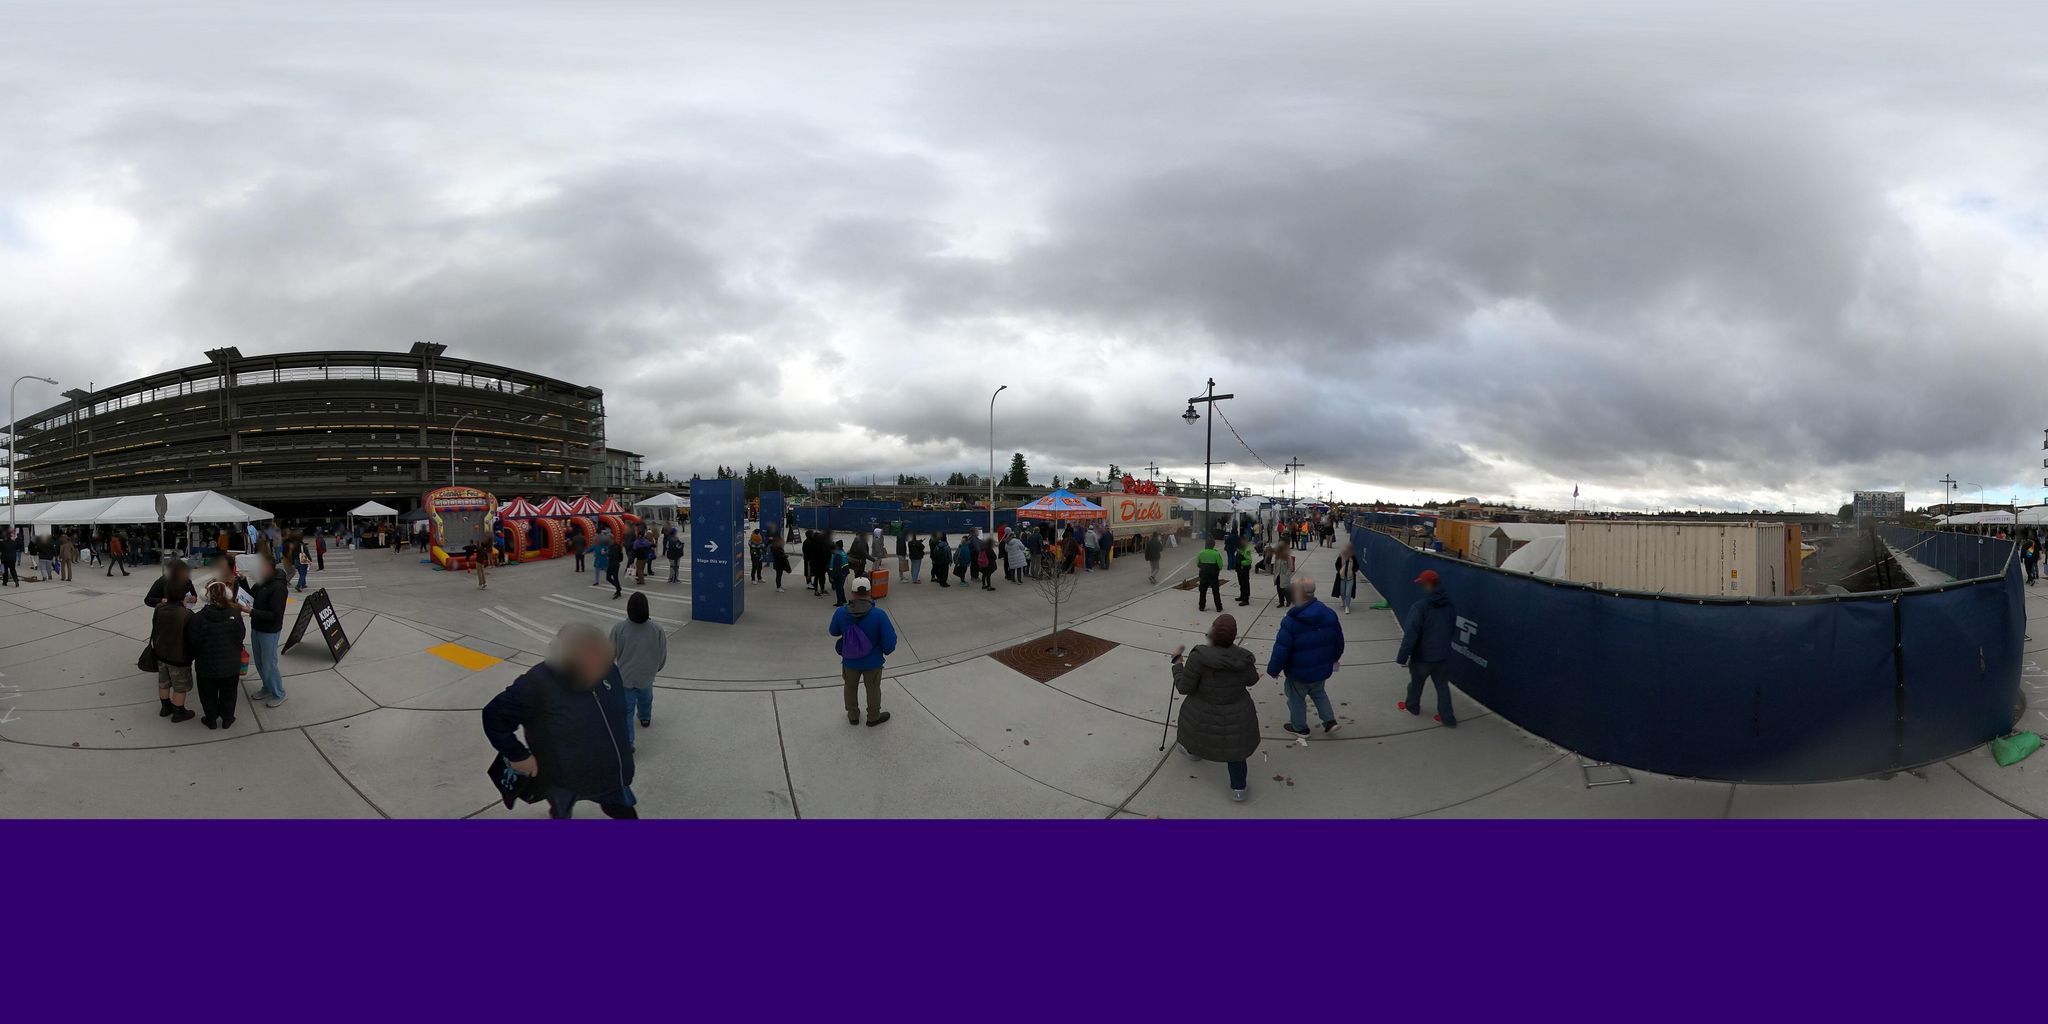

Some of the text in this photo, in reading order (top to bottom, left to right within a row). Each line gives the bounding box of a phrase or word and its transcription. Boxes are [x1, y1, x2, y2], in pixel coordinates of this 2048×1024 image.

[1120, 500, 1163, 521] Dick's
[319, 606, 333, 620] KIDS
[323, 615, 336, 630] ZONE
